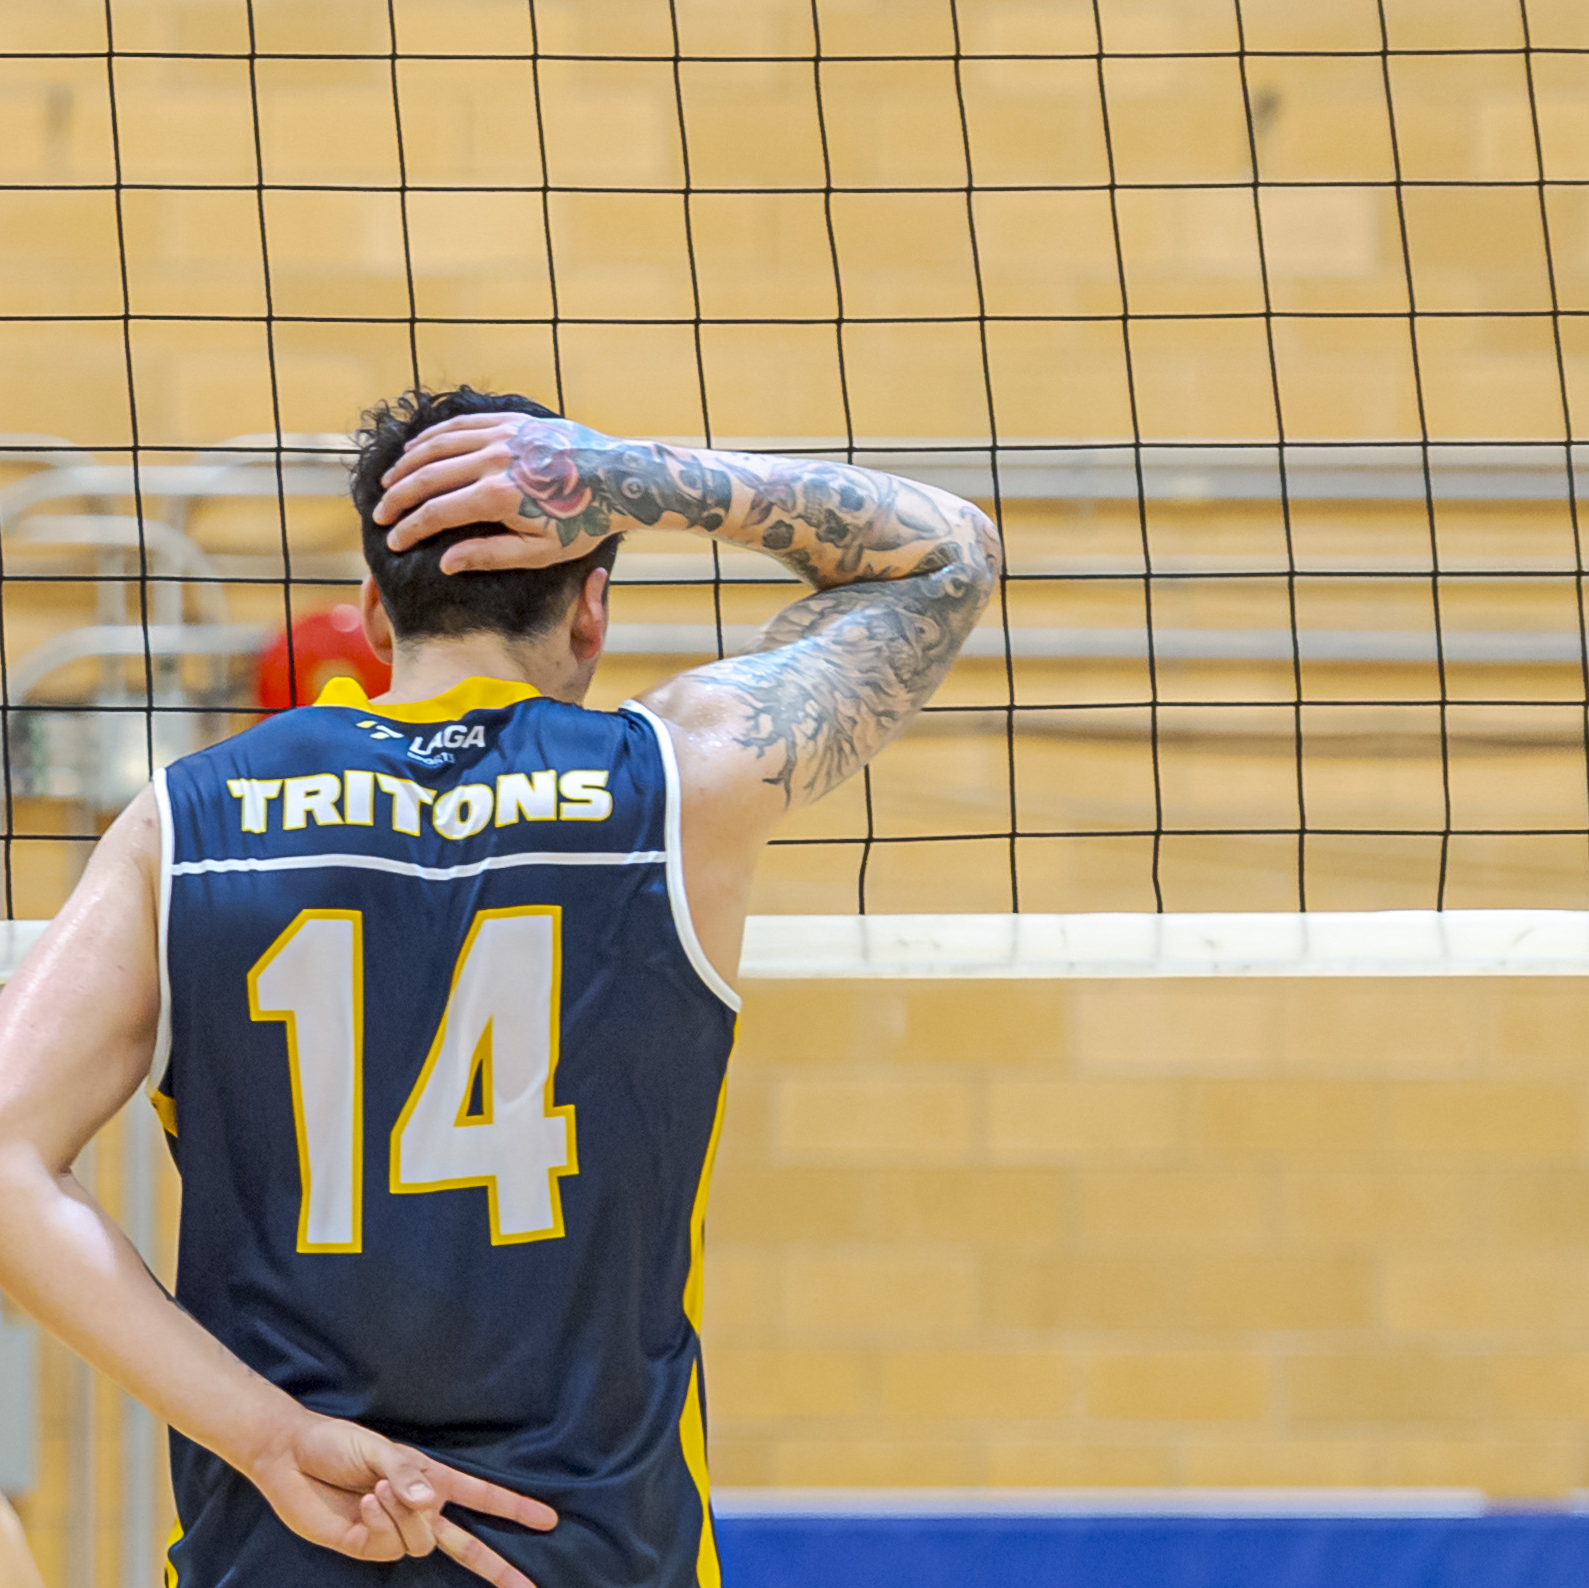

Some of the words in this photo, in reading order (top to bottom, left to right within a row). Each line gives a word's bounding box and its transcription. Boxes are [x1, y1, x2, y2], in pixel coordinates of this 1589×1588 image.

[408, 725, 486, 756] LAGA
[226, 769, 613, 841] TRITONS
[247, 904, 578, 1254] 14
